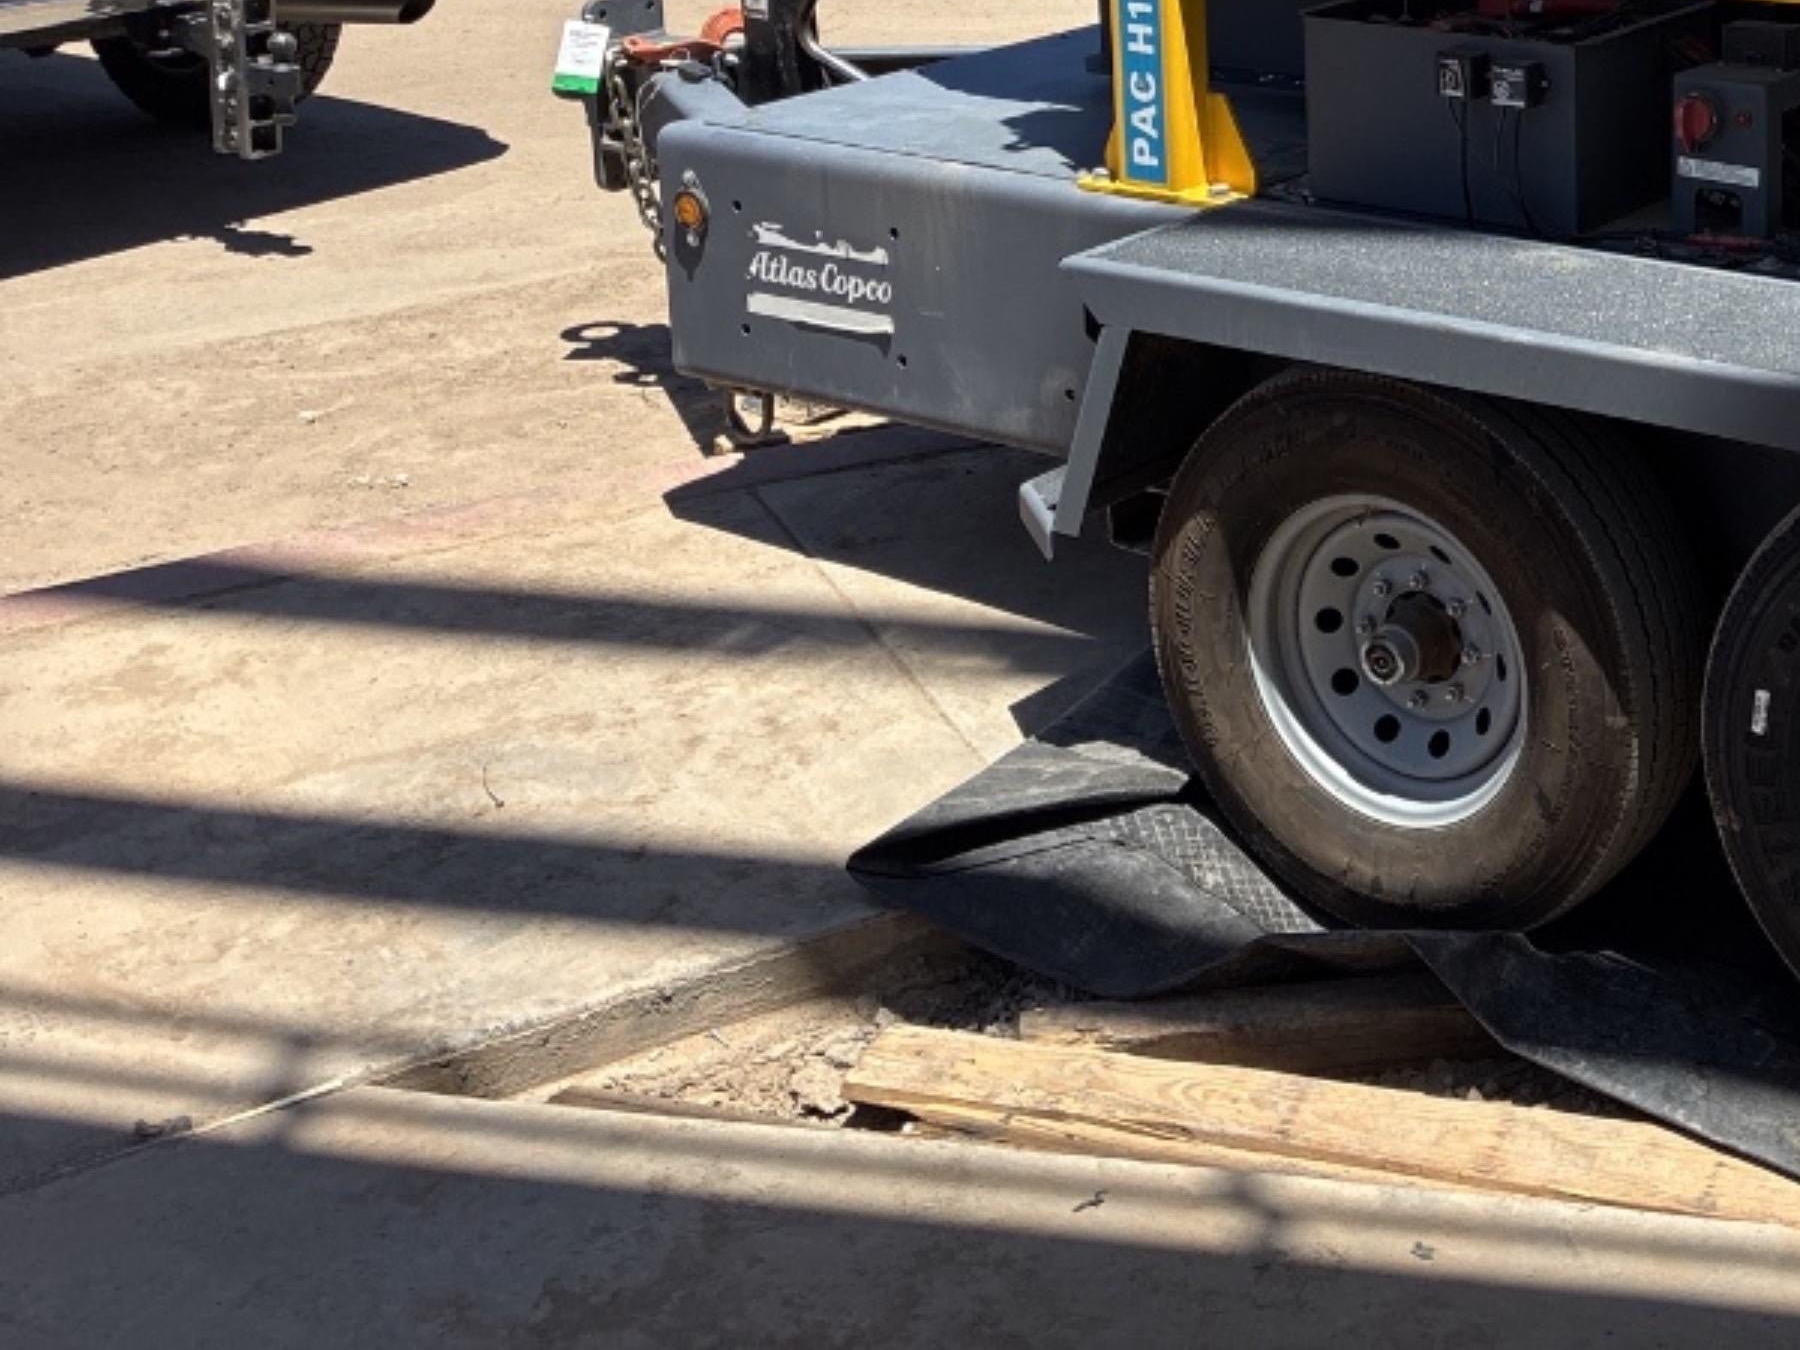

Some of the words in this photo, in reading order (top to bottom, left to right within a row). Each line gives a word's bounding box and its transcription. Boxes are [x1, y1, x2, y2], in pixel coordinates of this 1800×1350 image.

[1130, 71, 1159, 167] PAC
[747, 251, 817, 289] Atlas
[821, 263, 892, 304] Copco
